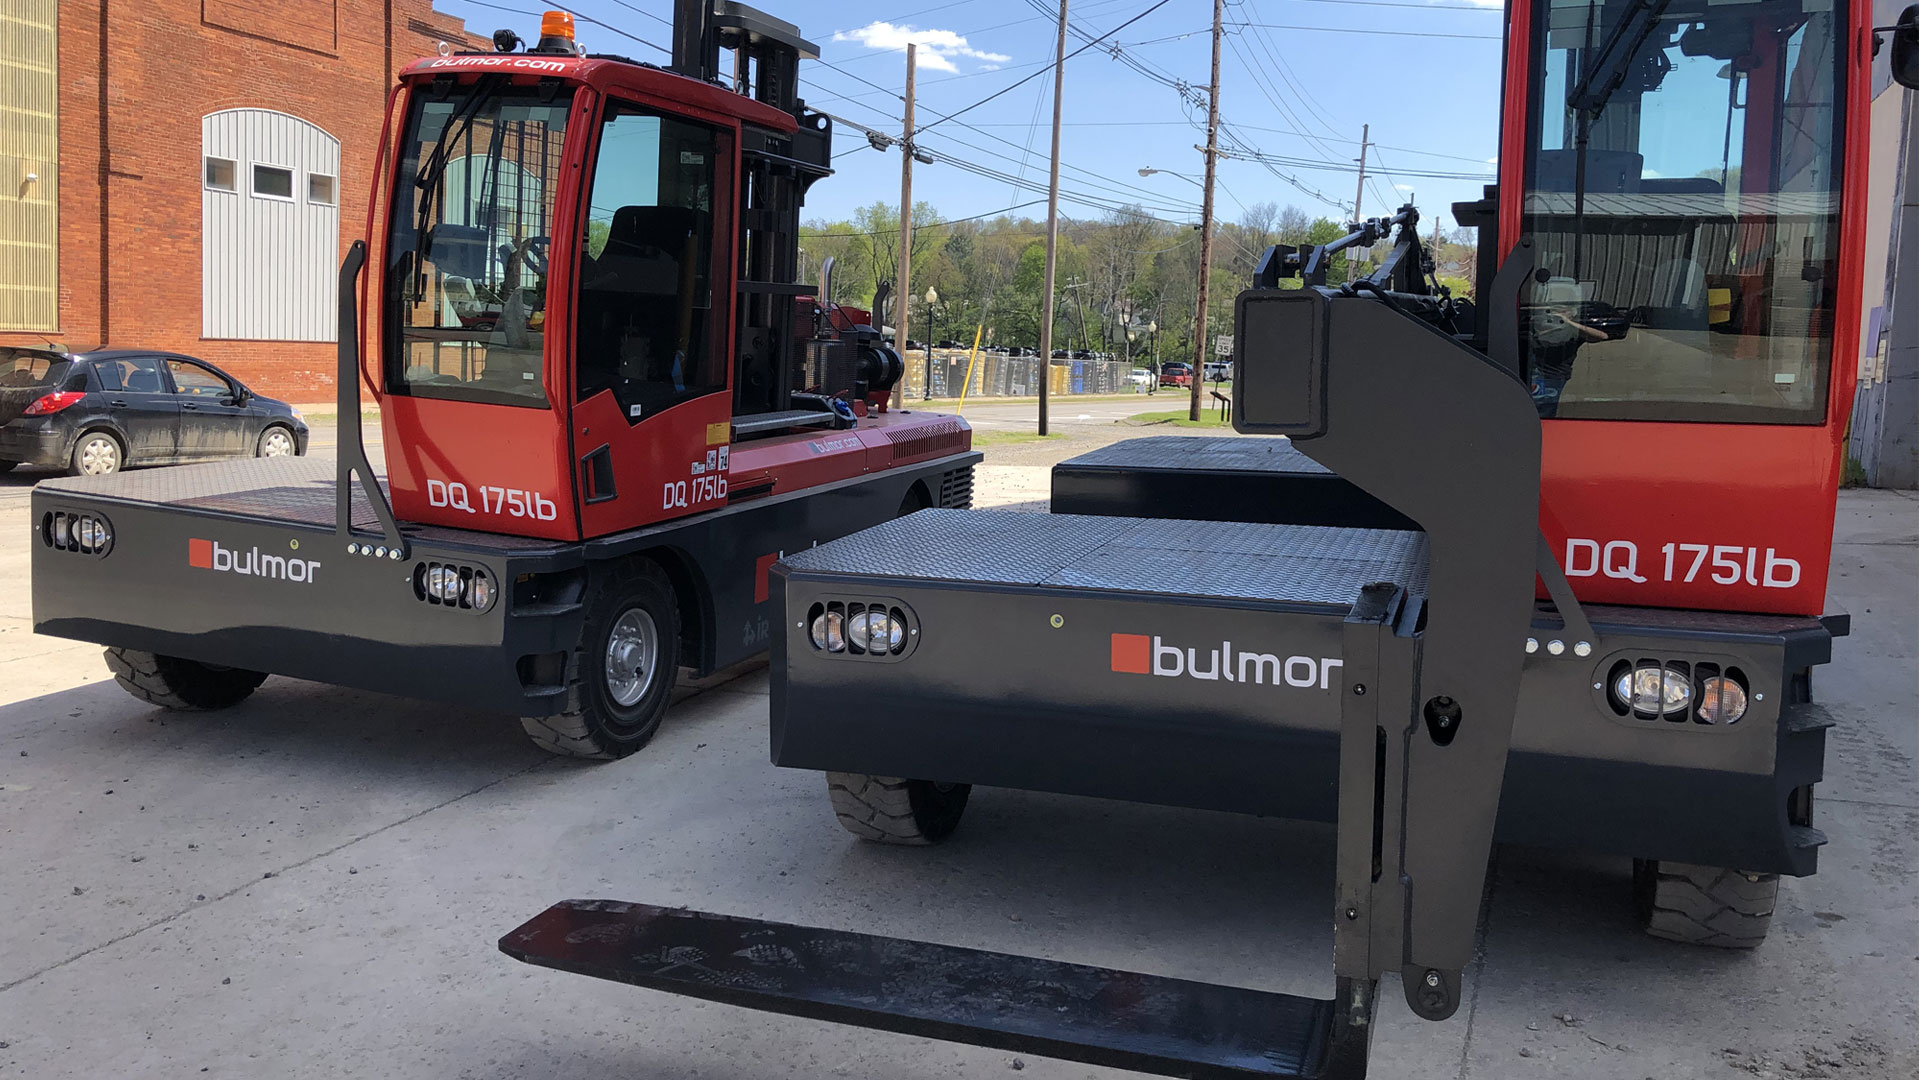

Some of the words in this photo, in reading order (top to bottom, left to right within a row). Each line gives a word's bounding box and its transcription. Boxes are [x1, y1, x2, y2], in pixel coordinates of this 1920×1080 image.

[431, 57, 566, 72] bulmor.com
[1217, 345, 1229, 353] 35
[813, 437, 861, 453] bulmor.com
[427, 480, 476, 514] DQ
[480, 485, 557, 521] 175lb
[663, 481, 687, 510] DQ
[691, 475, 727, 505] 175lb
[213, 541, 321, 583] bulmor
[1565, 538, 1647, 584] DQ
[1662, 543, 1801, 589] 175lb
[1152, 636, 1343, 689] bulmor
